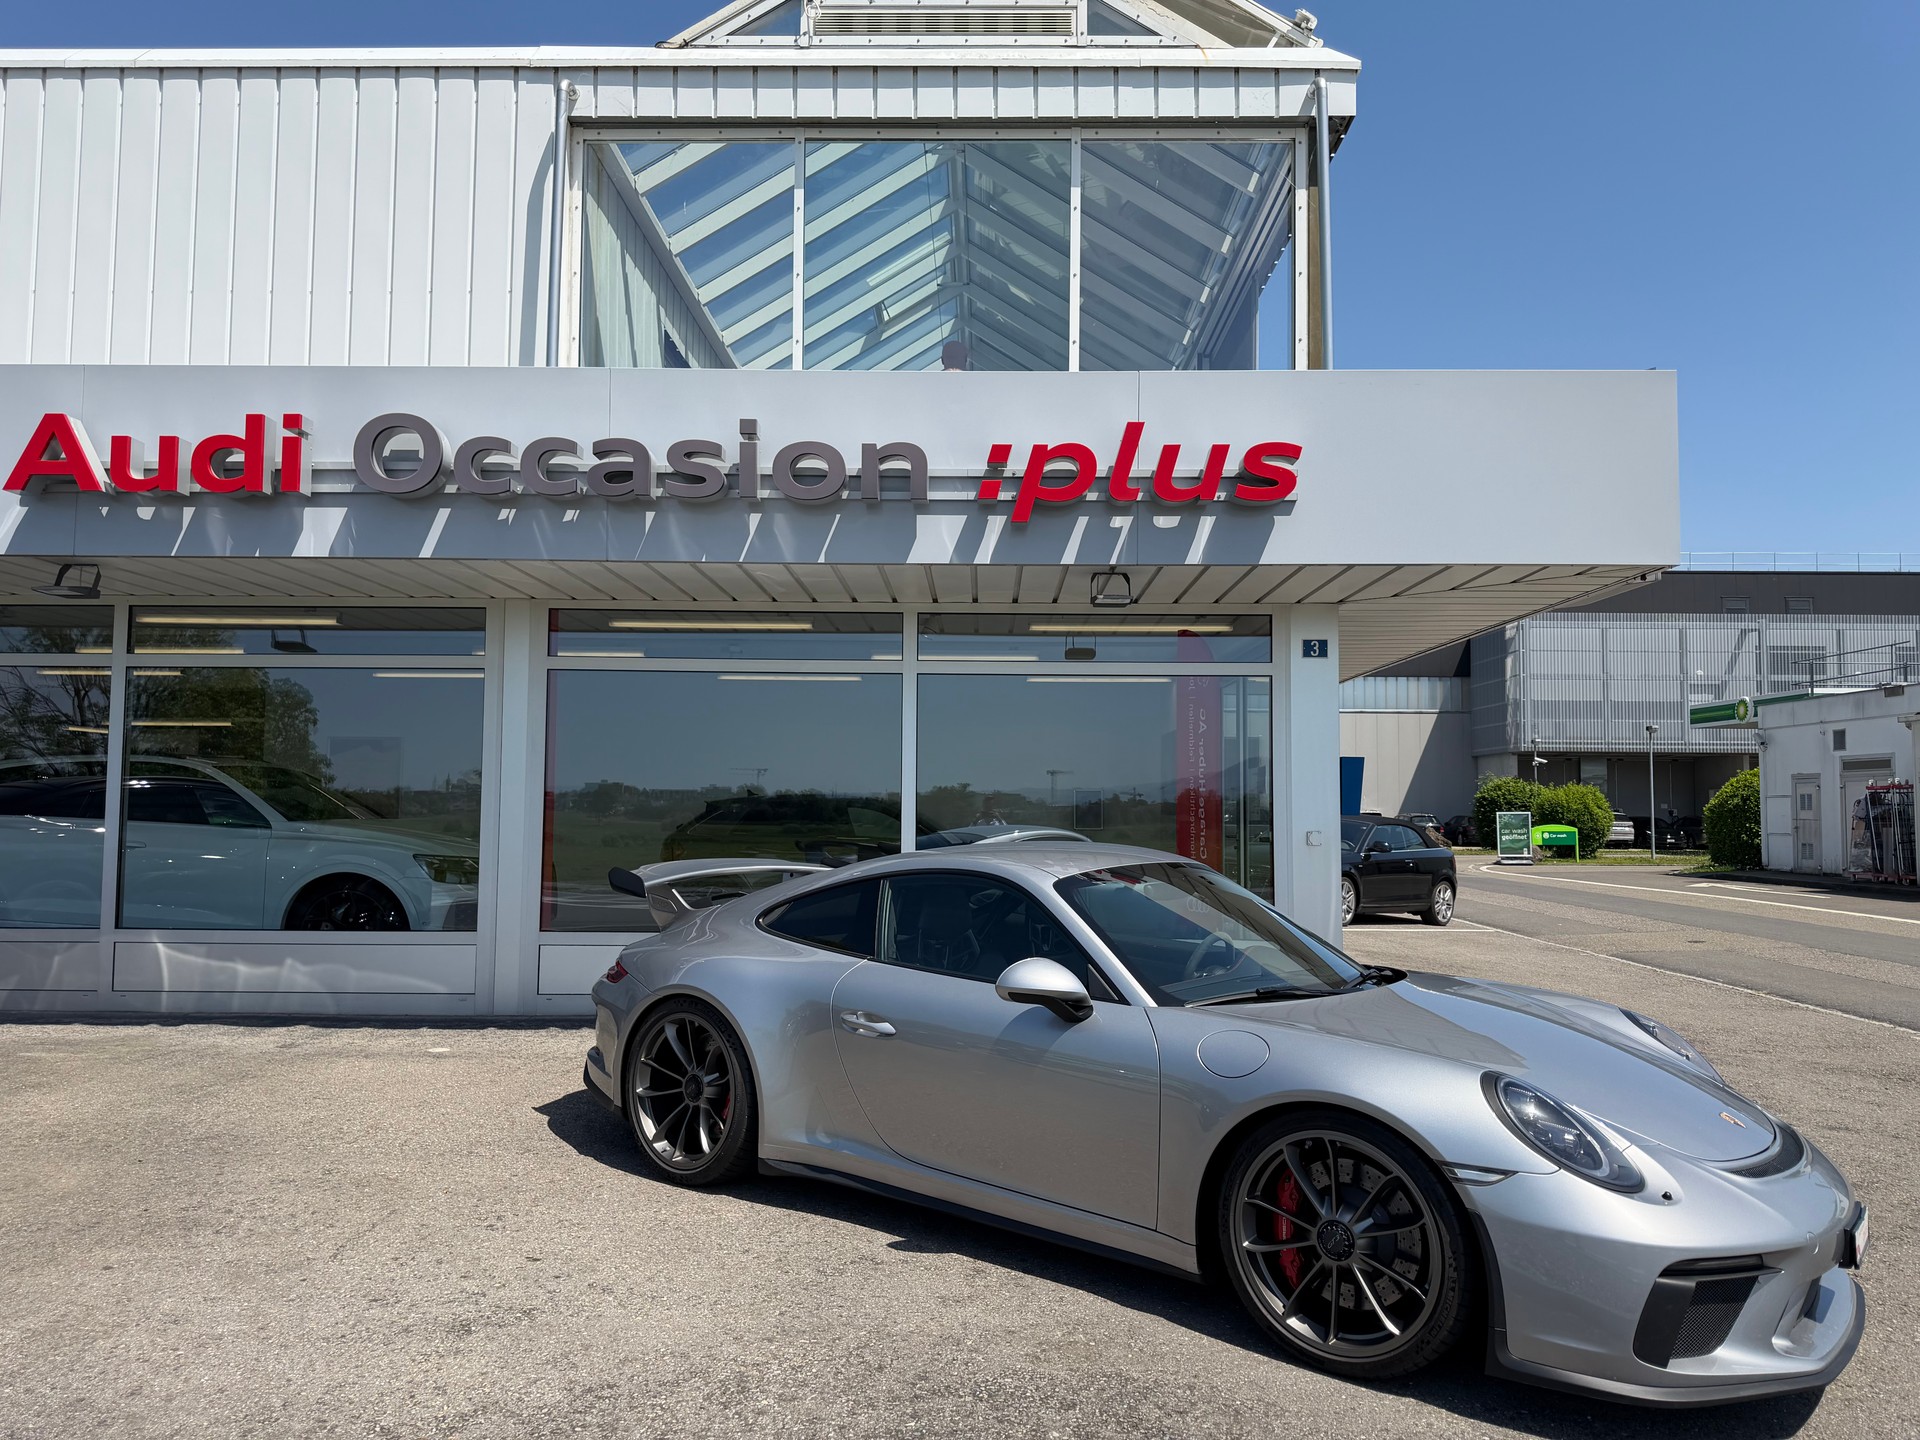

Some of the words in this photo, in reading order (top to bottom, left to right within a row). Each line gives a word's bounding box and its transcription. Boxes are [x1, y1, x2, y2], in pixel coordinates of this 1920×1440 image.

[3, 413, 306, 494] Audi
[352, 412, 929, 500] Occasion
[977, 421, 1303, 523] :plus
[1310, 640, 1320, 656] 3
[1327, 1234, 1340, 1248] GT3
